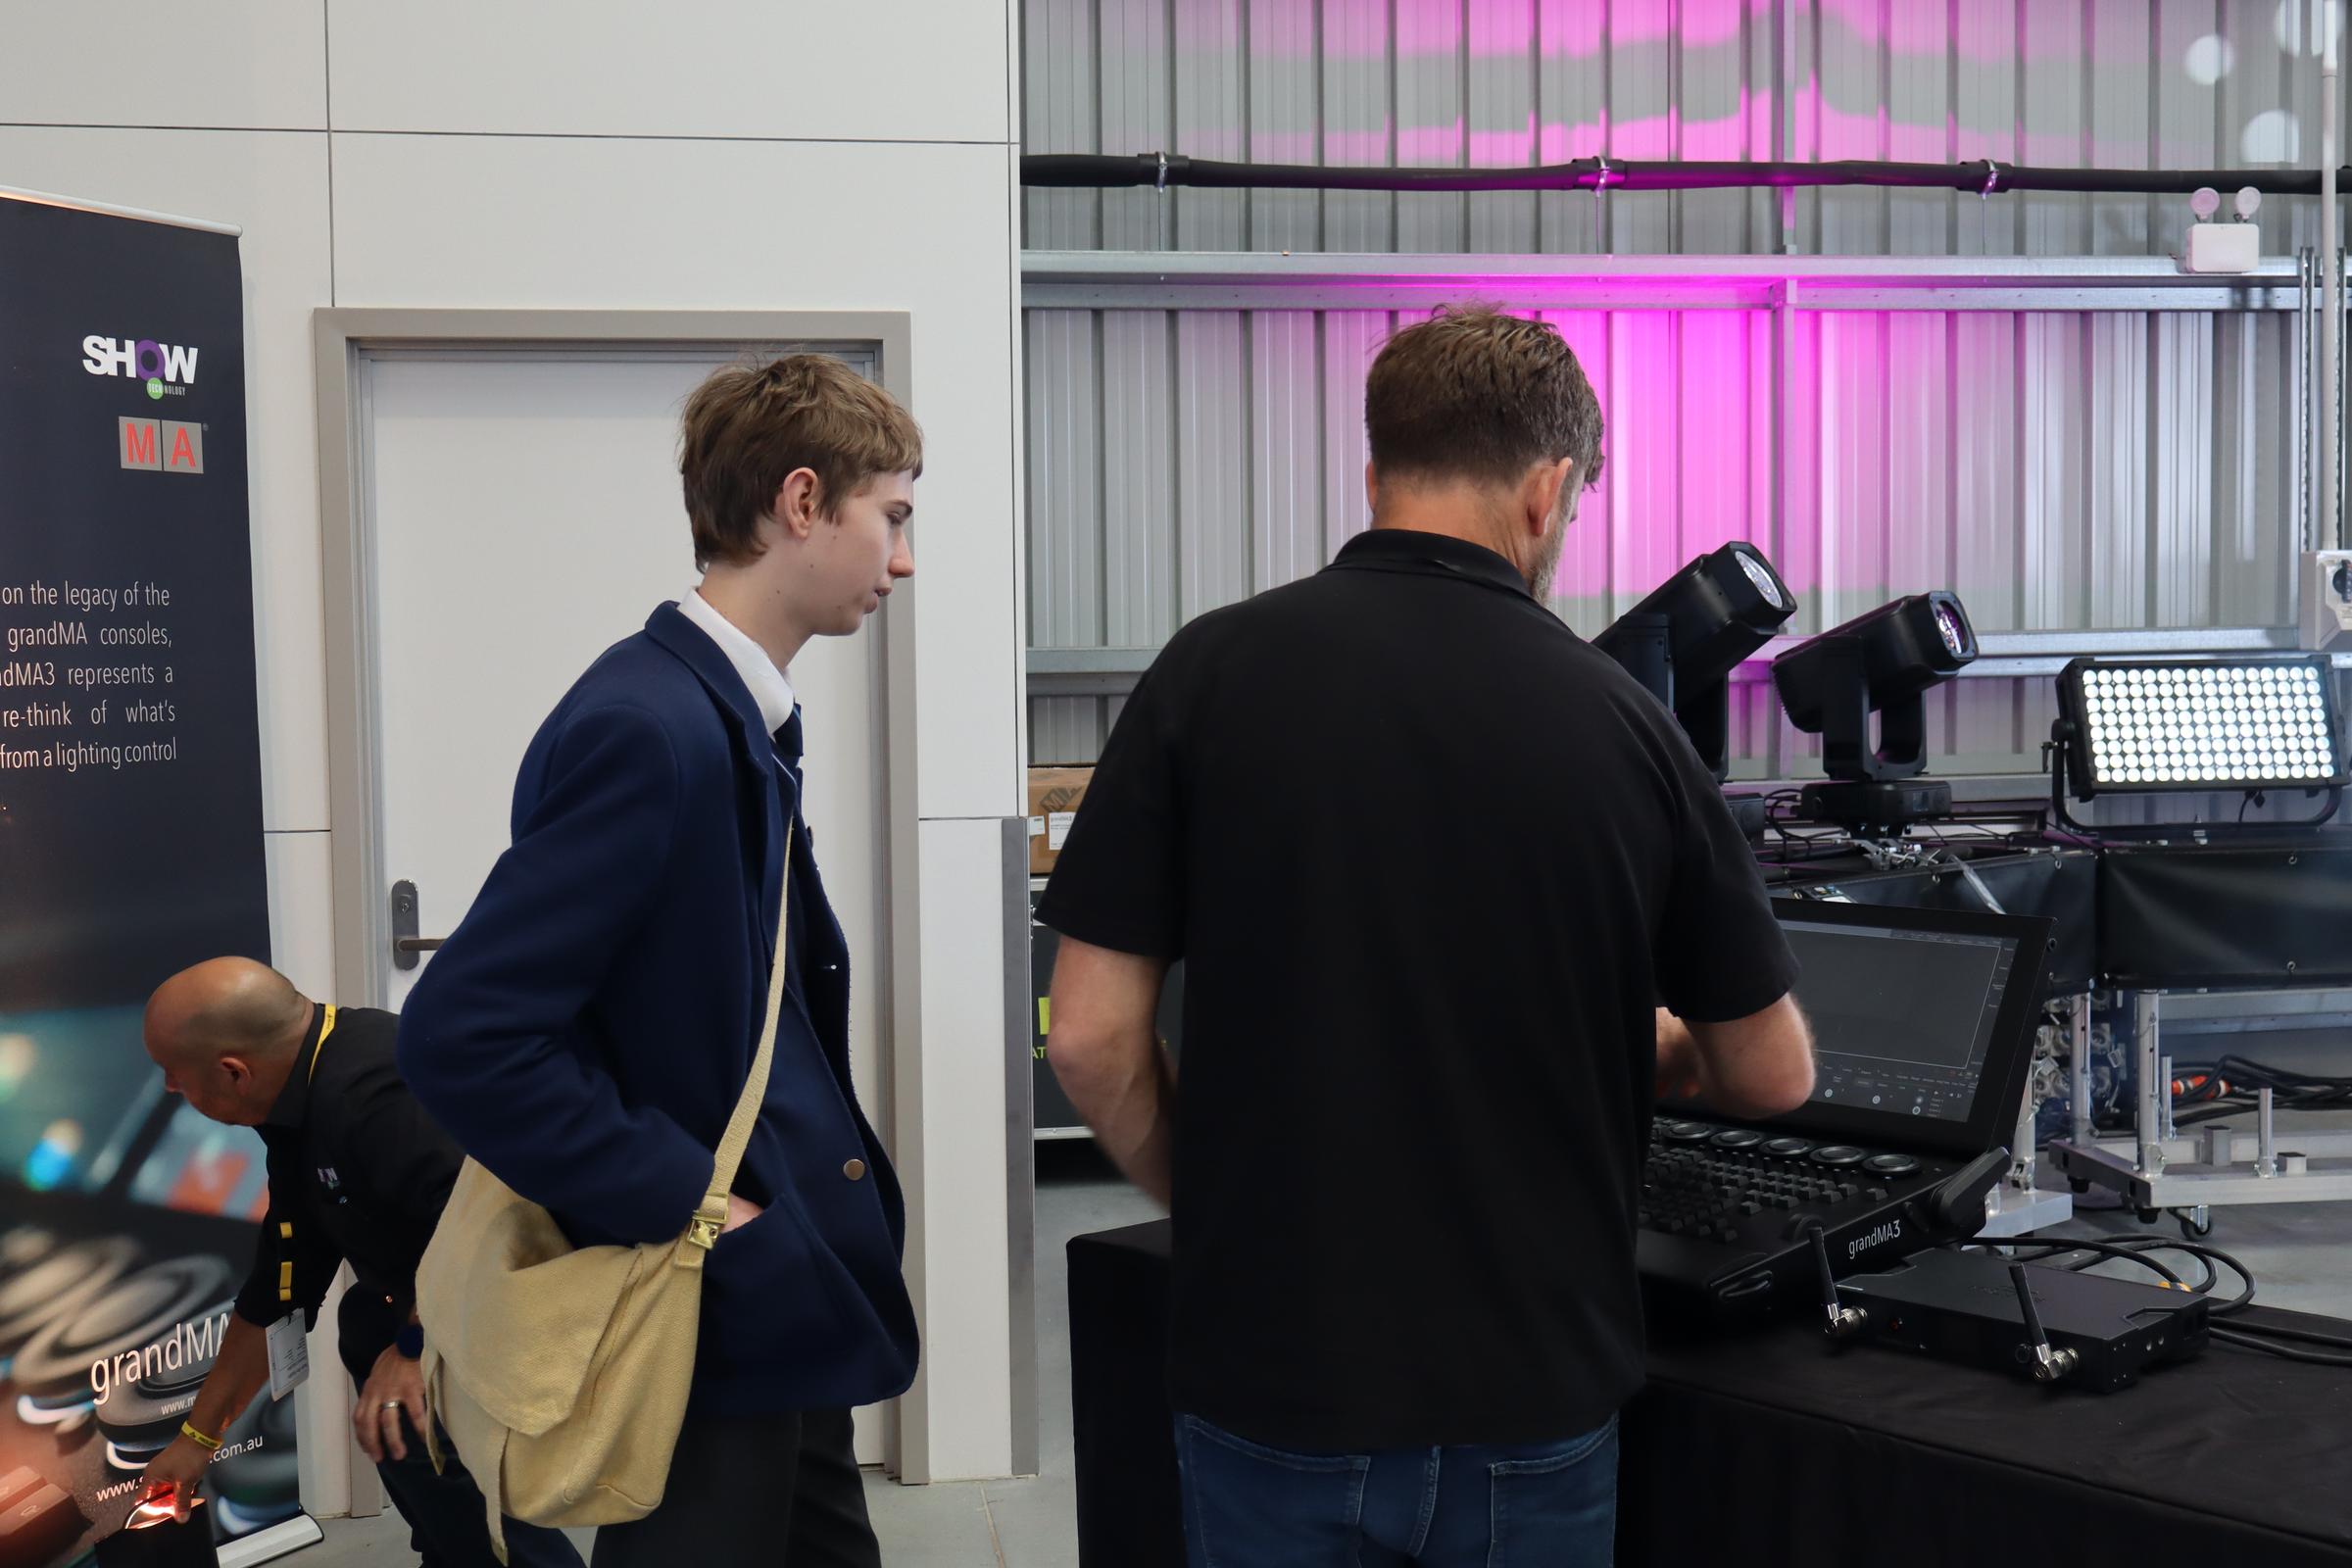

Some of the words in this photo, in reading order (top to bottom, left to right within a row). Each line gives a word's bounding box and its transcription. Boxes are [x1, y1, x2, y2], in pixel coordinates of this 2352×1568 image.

[82, 335, 198, 384] SHOW
[2, 587, 24, 605] on
[30, 580, 58, 605] the
[65, 580, 118, 612] legacy
[123, 581, 139, 606] of
[145, 582, 171, 606] the
[8, 620, 88, 652] grandMA
[100, 621, 172, 648] consoles,
[68, 663, 155, 692] represents
[165, 666, 173, 683] a
[3, 701, 73, 728] re-think
[90, 699, 108, 724] of
[125, 699, 175, 723] what's
[0, 744, 39, 768] from
[43, 749, 53, 766] a
[56, 741, 122, 772] lighting
[124, 737, 176, 762] control
[1848, 1219, 1901, 1260] grandMA3
